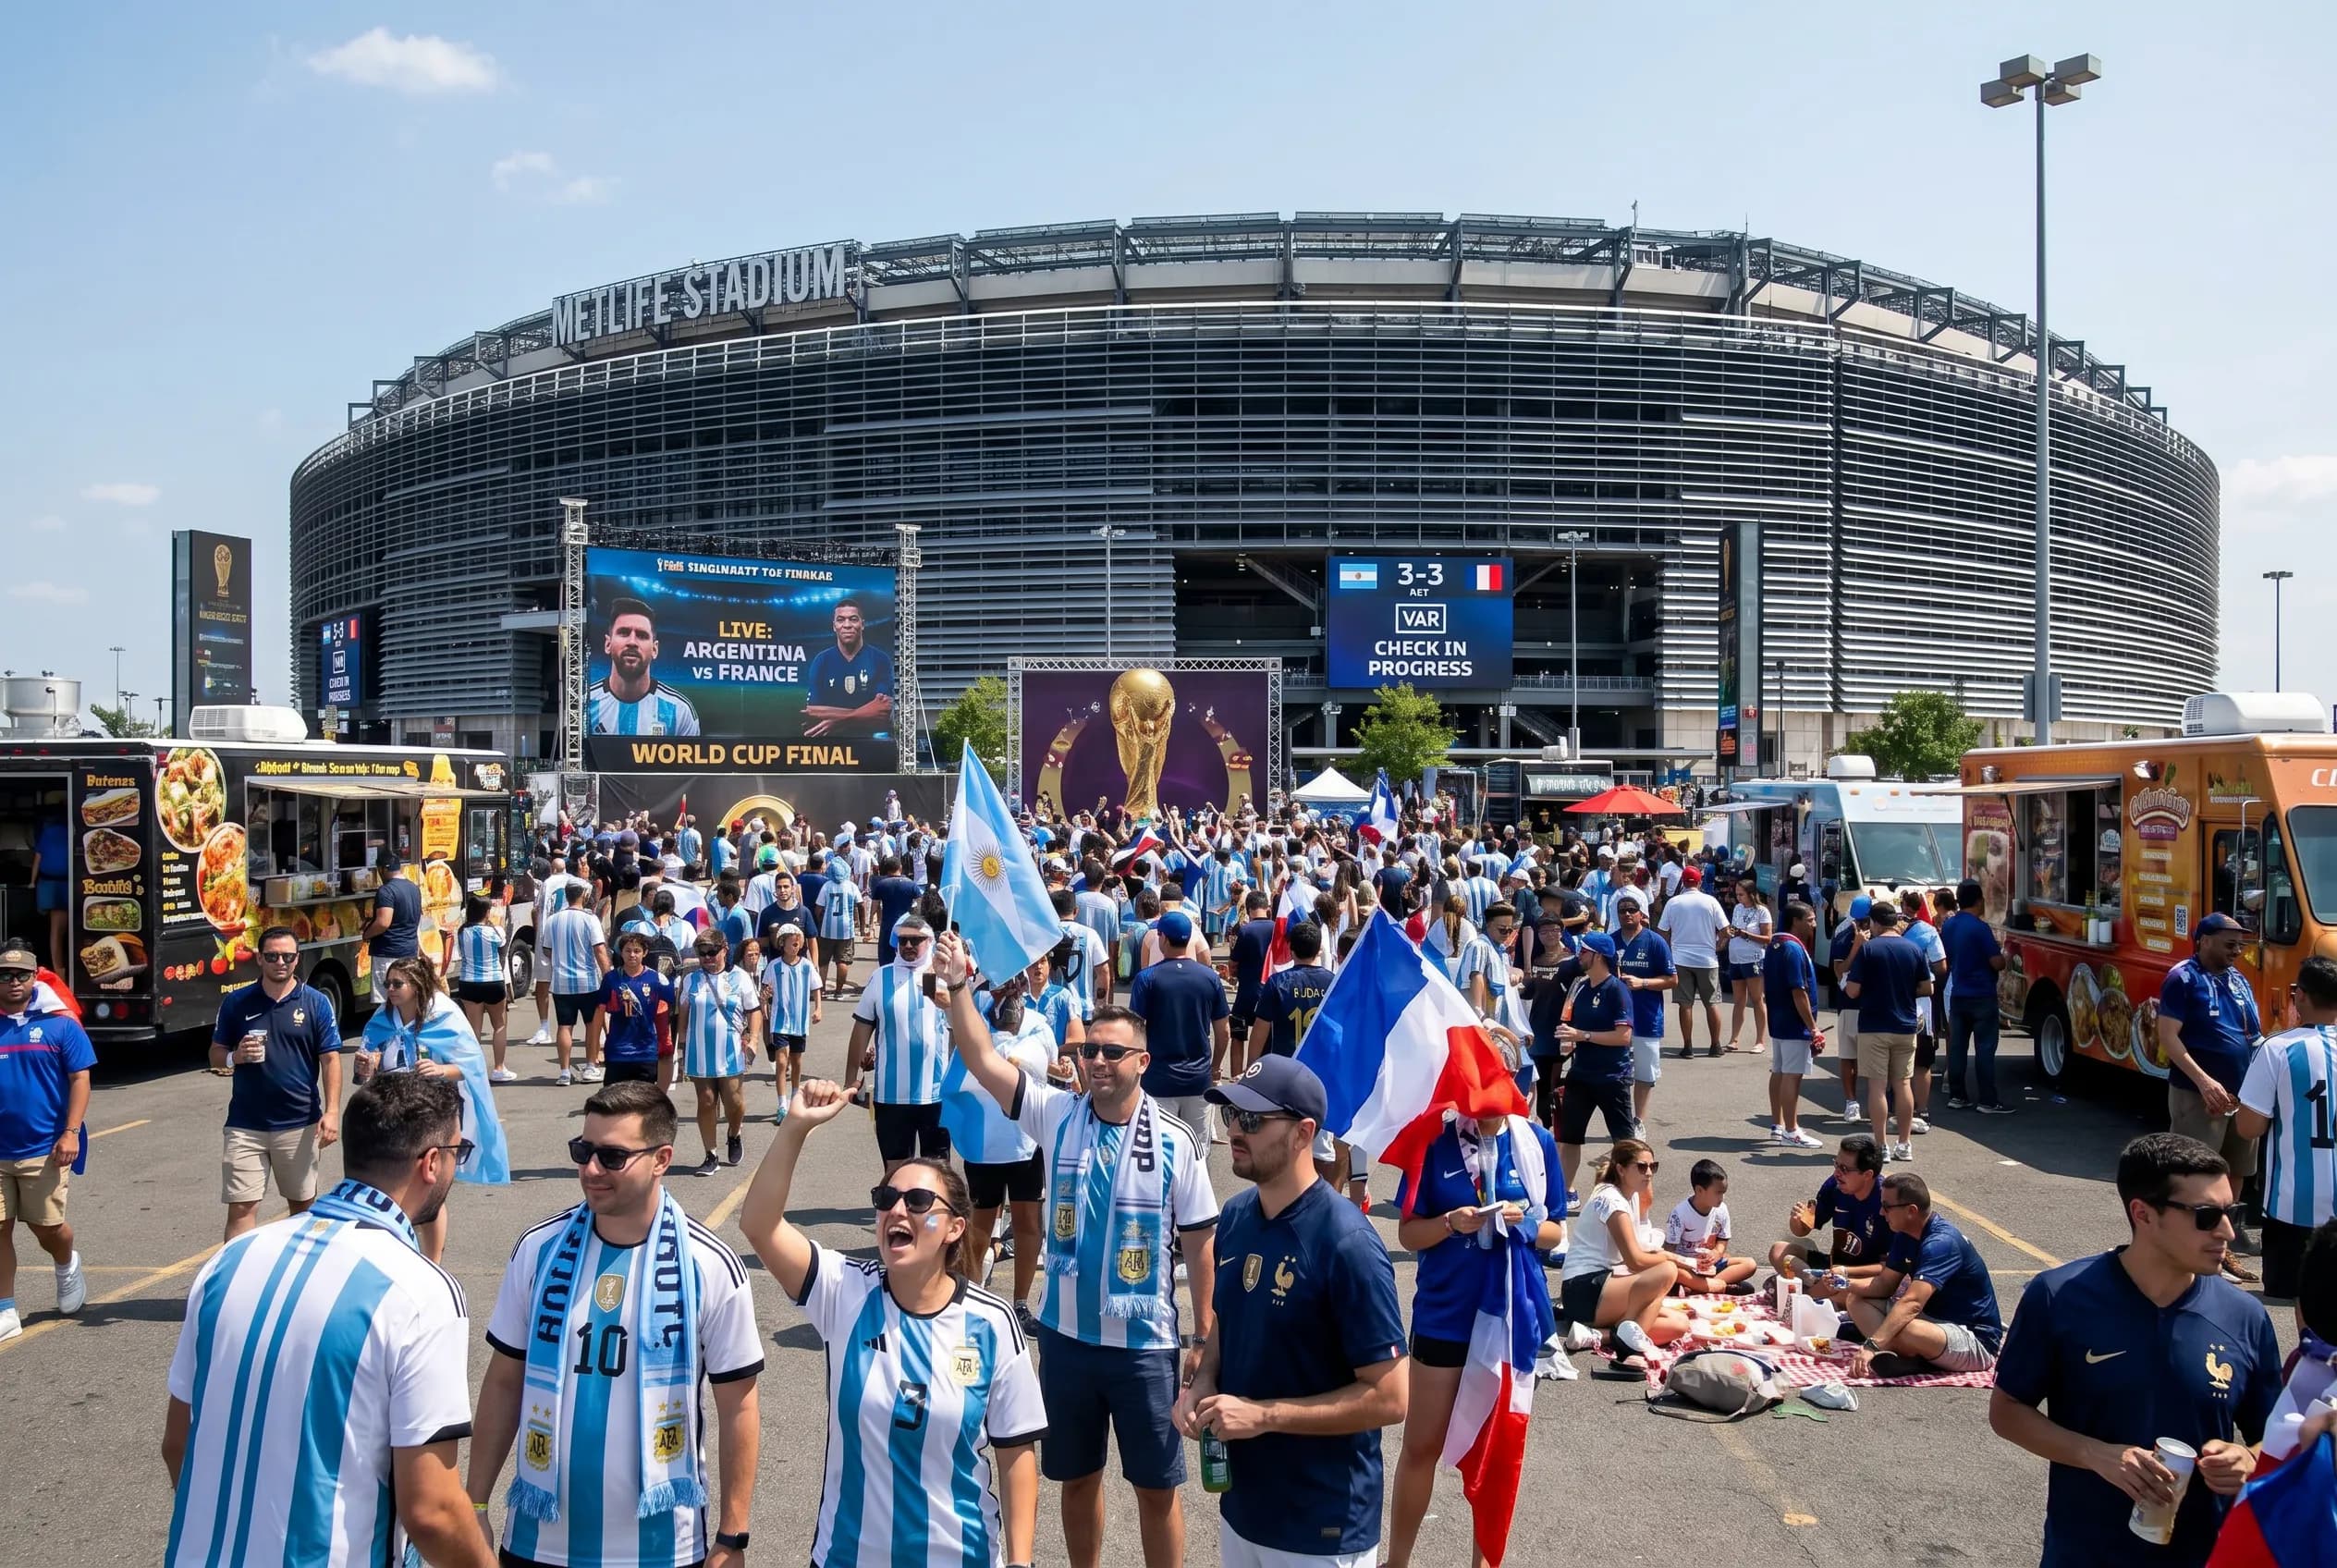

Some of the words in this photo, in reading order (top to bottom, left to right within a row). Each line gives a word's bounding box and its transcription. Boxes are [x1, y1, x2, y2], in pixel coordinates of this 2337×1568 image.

[553, 276, 672, 348] METLIFE
[682, 245, 846, 320] STADIUM
[1397, 562, 1444, 586] 3-3
[1409, 588, 1429, 597] AET
[1402, 609, 1439, 627] VAR
[719, 620, 773, 640] LIVE:
[682, 641, 807, 662] ARGENTINA
[1374, 641, 1441, 656] CHECK
[1444, 641, 1467, 656] IN
[718, 663, 799, 682] FRANCE
[1368, 660, 1473, 677] PROGRESS
[631, 742, 726, 765] WORLD
[732, 744, 781, 765] CUP
[787, 745, 859, 766] FINAL
[573, 1322, 628, 1378] 10
